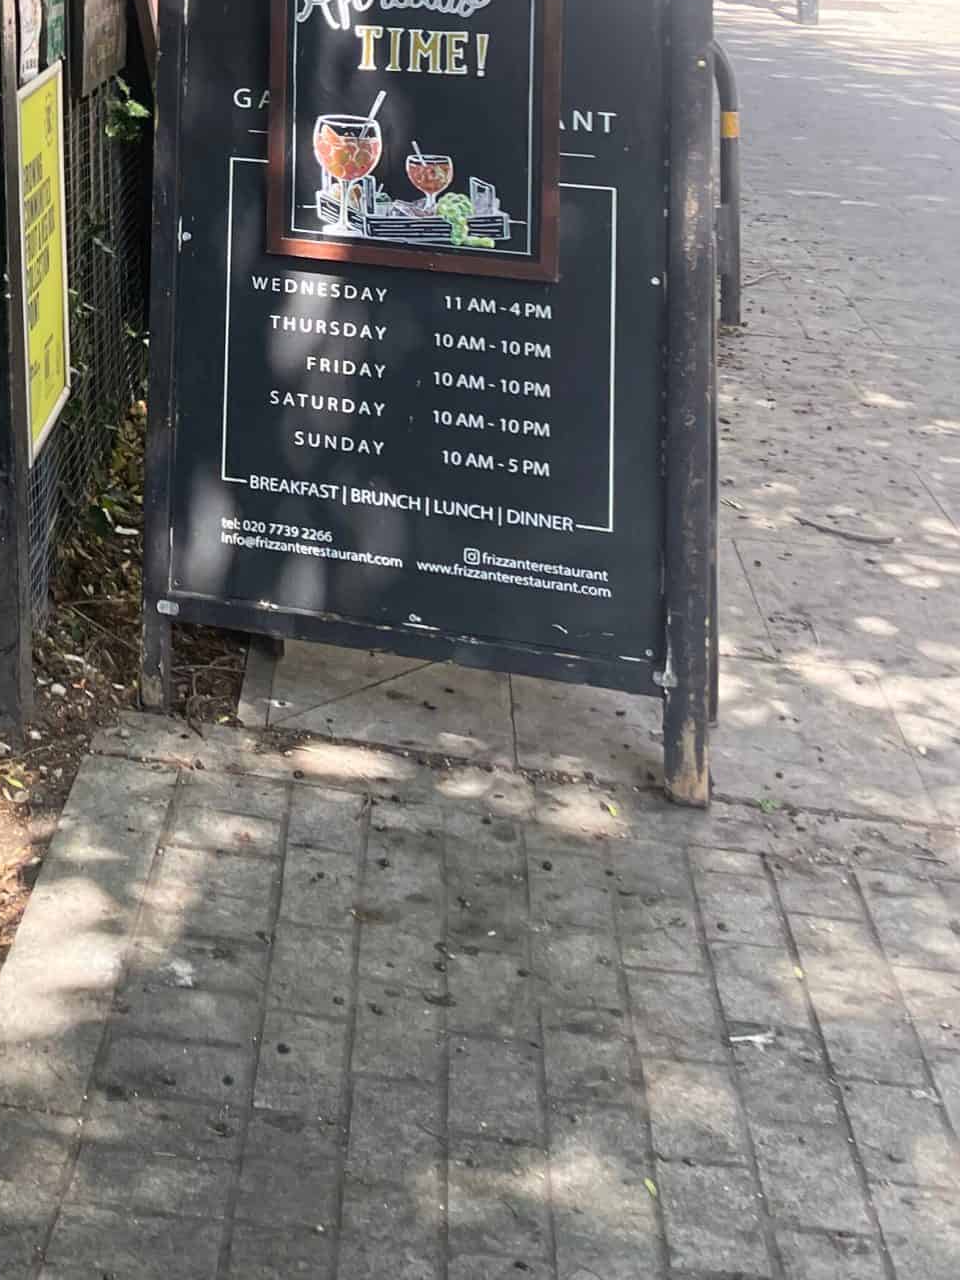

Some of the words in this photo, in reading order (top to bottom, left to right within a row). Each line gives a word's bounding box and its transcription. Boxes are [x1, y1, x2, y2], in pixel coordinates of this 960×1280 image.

[355, 25, 490, 77] TIME!
[251, 275, 388, 302] WEDNESDAY
[445, 295, 462, 310] 11
[467, 297, 497, 314] AM
[509, 302, 521, 316] 4
[524, 302, 552, 320] PM
[269, 314, 387, 340] THURSDAY
[434, 332, 454, 348] 10
[456, 335, 486, 352] AM
[501, 340, 521, 356] 10
[524, 341, 551, 359] PM
[306, 356, 386, 379] FRIDAY
[433, 371, 453, 387] 10
[455, 373, 485, 391] AM
[500, 379, 520, 395] 10
[523, 381, 551, 398] PM
[269, 390, 385, 417] SATURDAY
[432, 410, 452, 426] 10
[455, 413, 485, 429] AM
[500, 418, 520, 434] 10
[523, 420, 551, 438] PM
[294, 430, 385, 455] SUNDAY
[442, 450, 462, 466] 10
[465, 452, 494, 470] AM
[507, 458, 519, 473] 5
[522, 460, 550, 477] PM
[249, 474, 340, 500] BREAKFAST
[351, 487, 422, 512] BRUNCH
[434, 498, 493, 521] LUNCH
[506, 508, 575, 532] DINNER
[242, 520, 266, 534] 020
[269, 523, 300, 538] 7739
[301, 527, 333, 543] 2266
[416, 560, 612, 598] www.frizzanterestaurant.com
[482, 552, 609, 583] frizzanterestaurant
